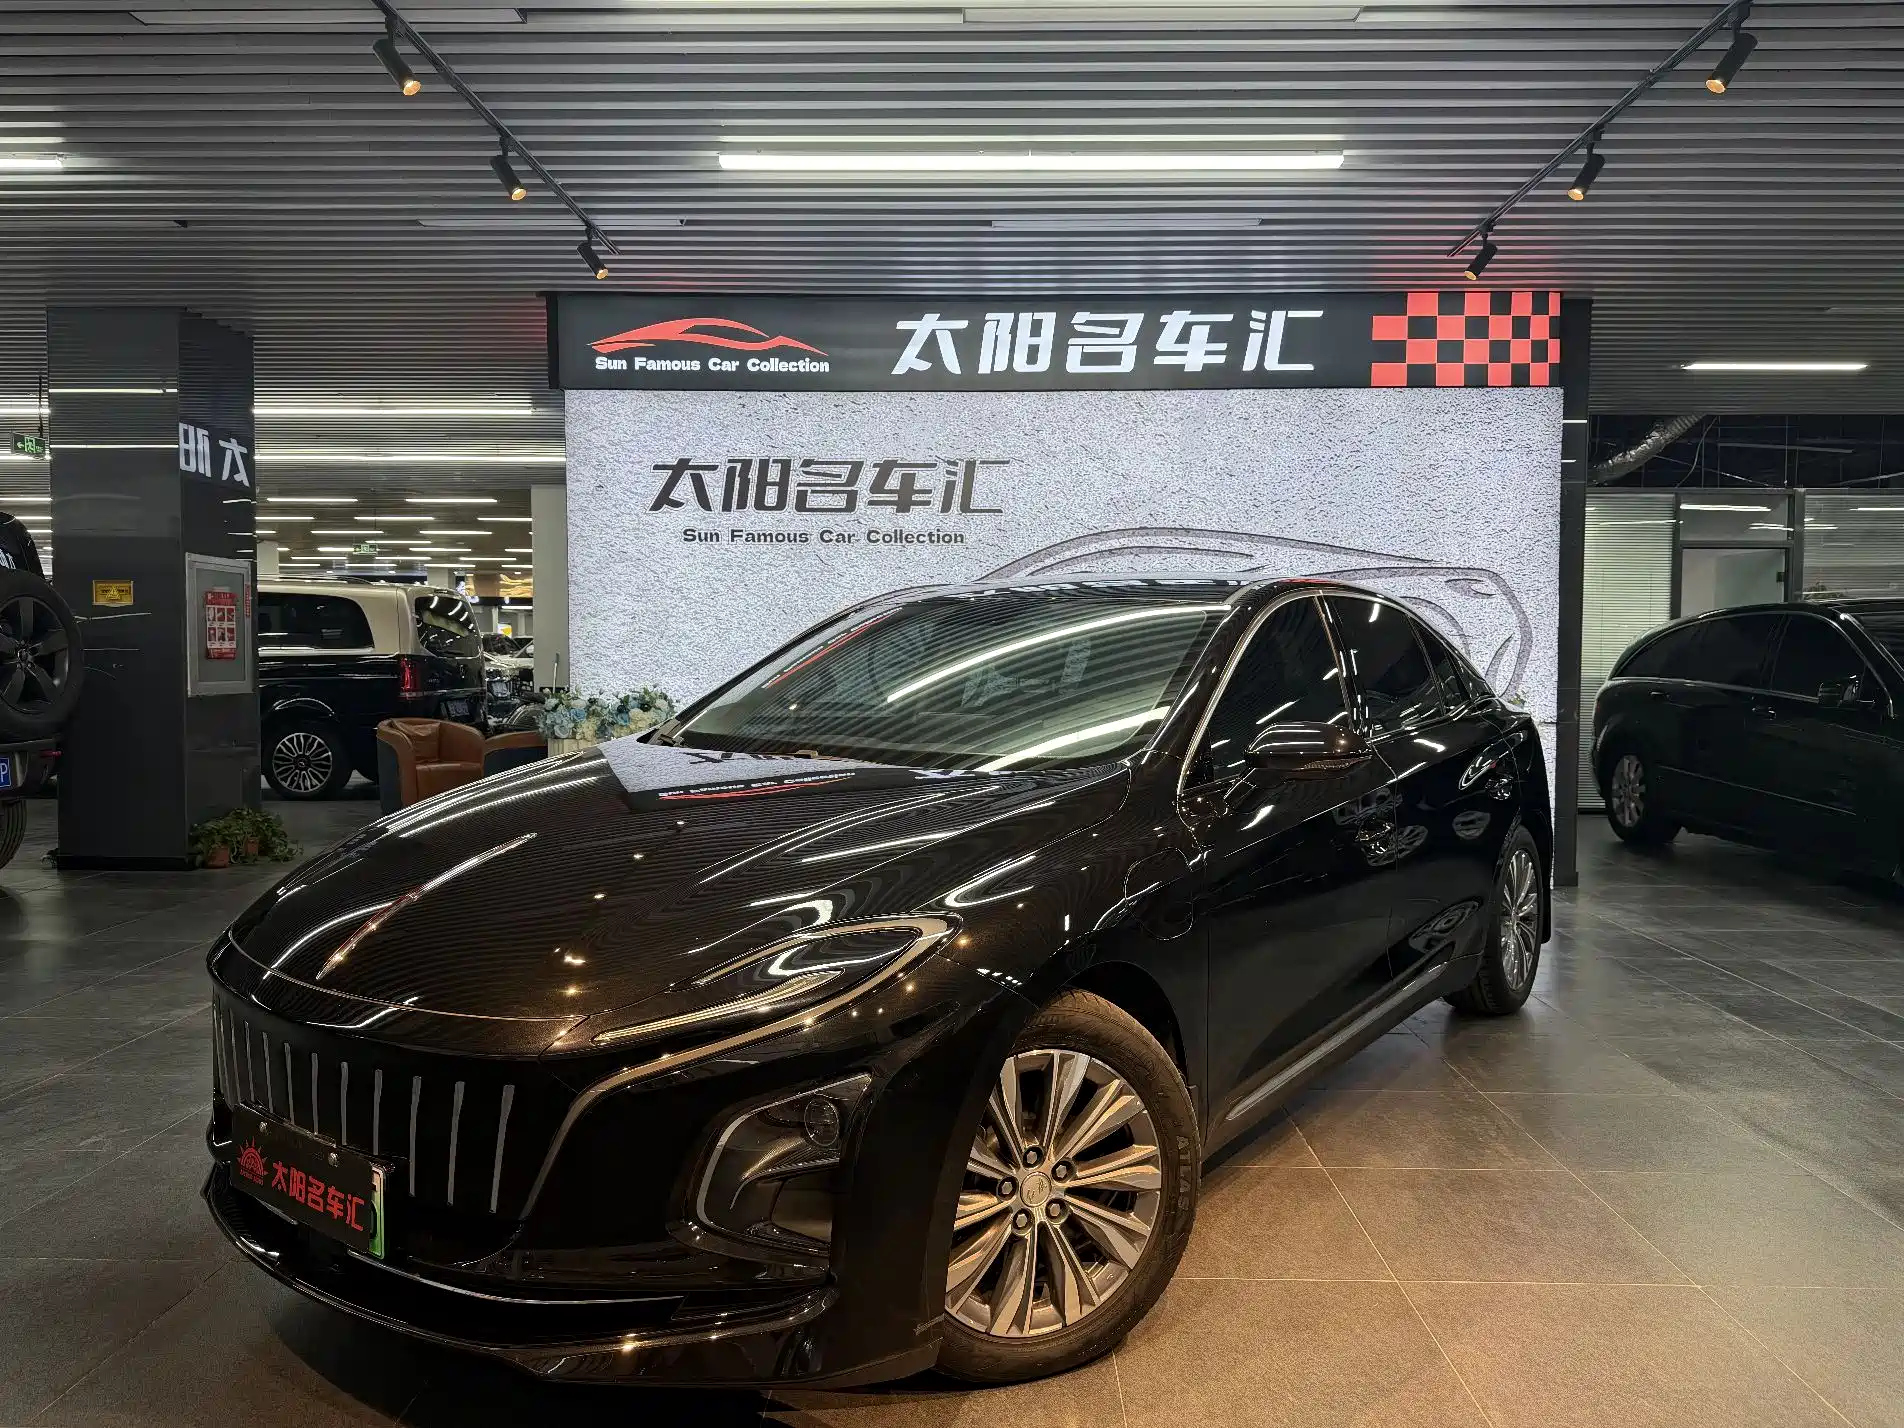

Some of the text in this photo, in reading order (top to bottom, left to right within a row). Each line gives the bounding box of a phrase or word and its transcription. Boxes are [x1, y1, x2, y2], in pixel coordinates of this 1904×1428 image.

[595, 357, 830, 372] Sun Famous Car Collection
[891, 310, 1324, 375] 太阳名车汇
[648, 458, 1011, 514] 太阳名车汇
[683, 528, 965, 544] Sun Famous Car Collection
[271, 1161, 365, 1232] 太阳名车汇
[1177, 1136, 1192, 1210] ATLAS
